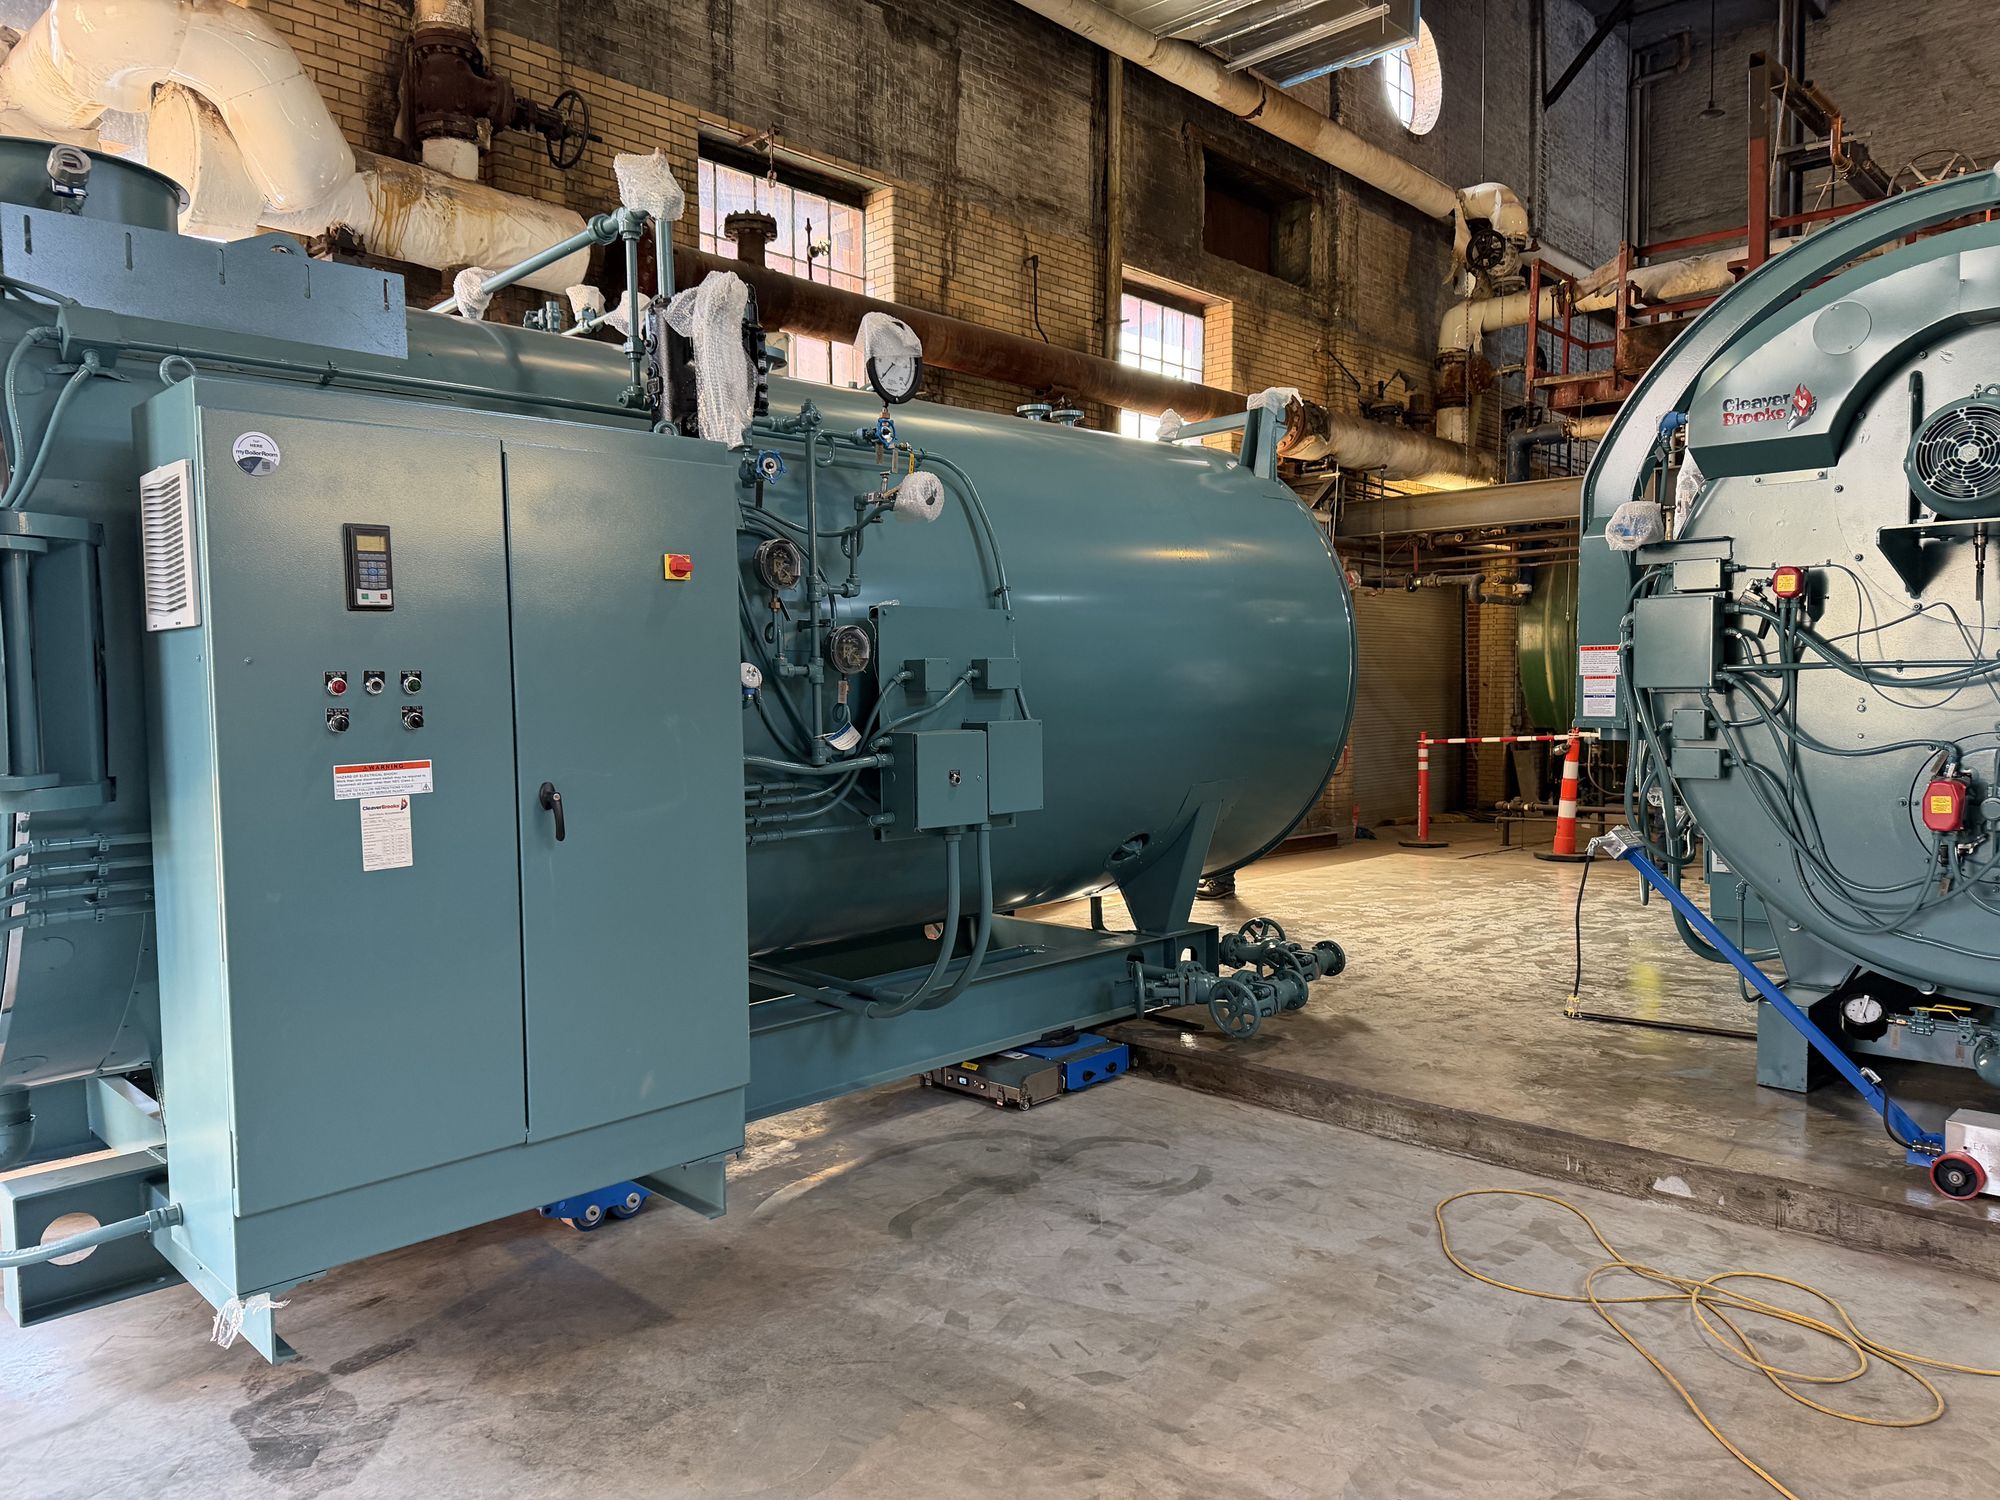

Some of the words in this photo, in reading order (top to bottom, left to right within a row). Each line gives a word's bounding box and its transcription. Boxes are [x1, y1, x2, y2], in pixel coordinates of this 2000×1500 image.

[1722, 393, 1790, 412] Cleaver
[1723, 408, 1786, 426] Brooks
[368, 763, 404, 771] WARNING
